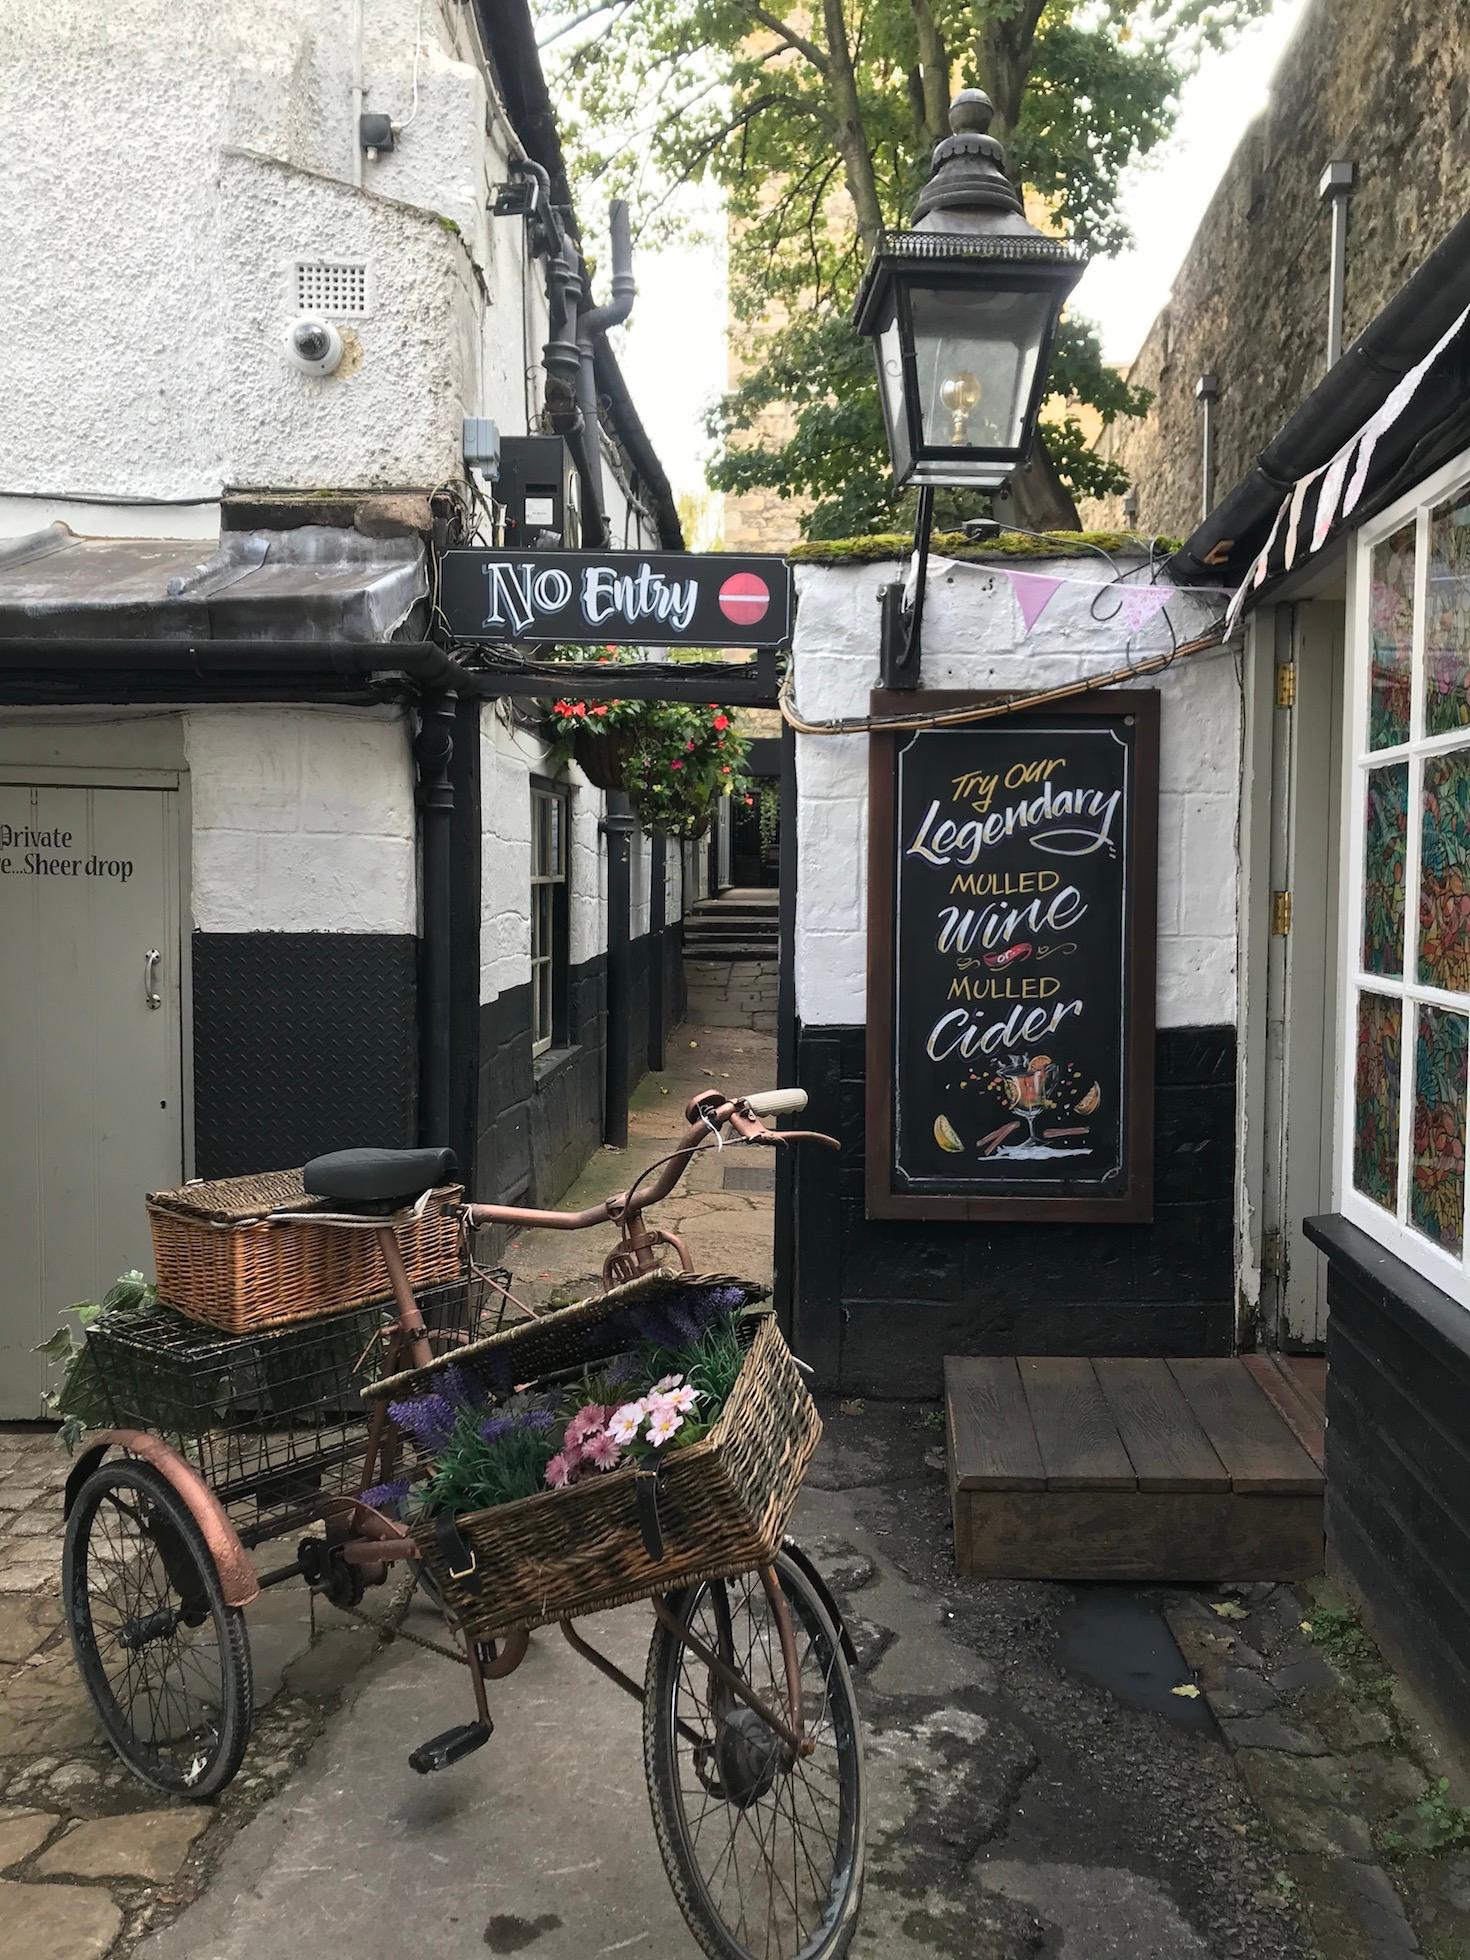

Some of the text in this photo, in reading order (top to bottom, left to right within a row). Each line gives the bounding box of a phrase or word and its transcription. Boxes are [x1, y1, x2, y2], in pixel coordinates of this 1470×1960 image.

[482, 562, 698, 636] No Entry
[951, 758, 1066, 813] Try Our
[0, 824, 72, 850] Private
[906, 781, 1122, 864] Legendary
[950, 870, 1060, 896] MULLED
[947, 976, 1060, 1000] MULLED
[926, 1000, 1083, 1062] Cider
